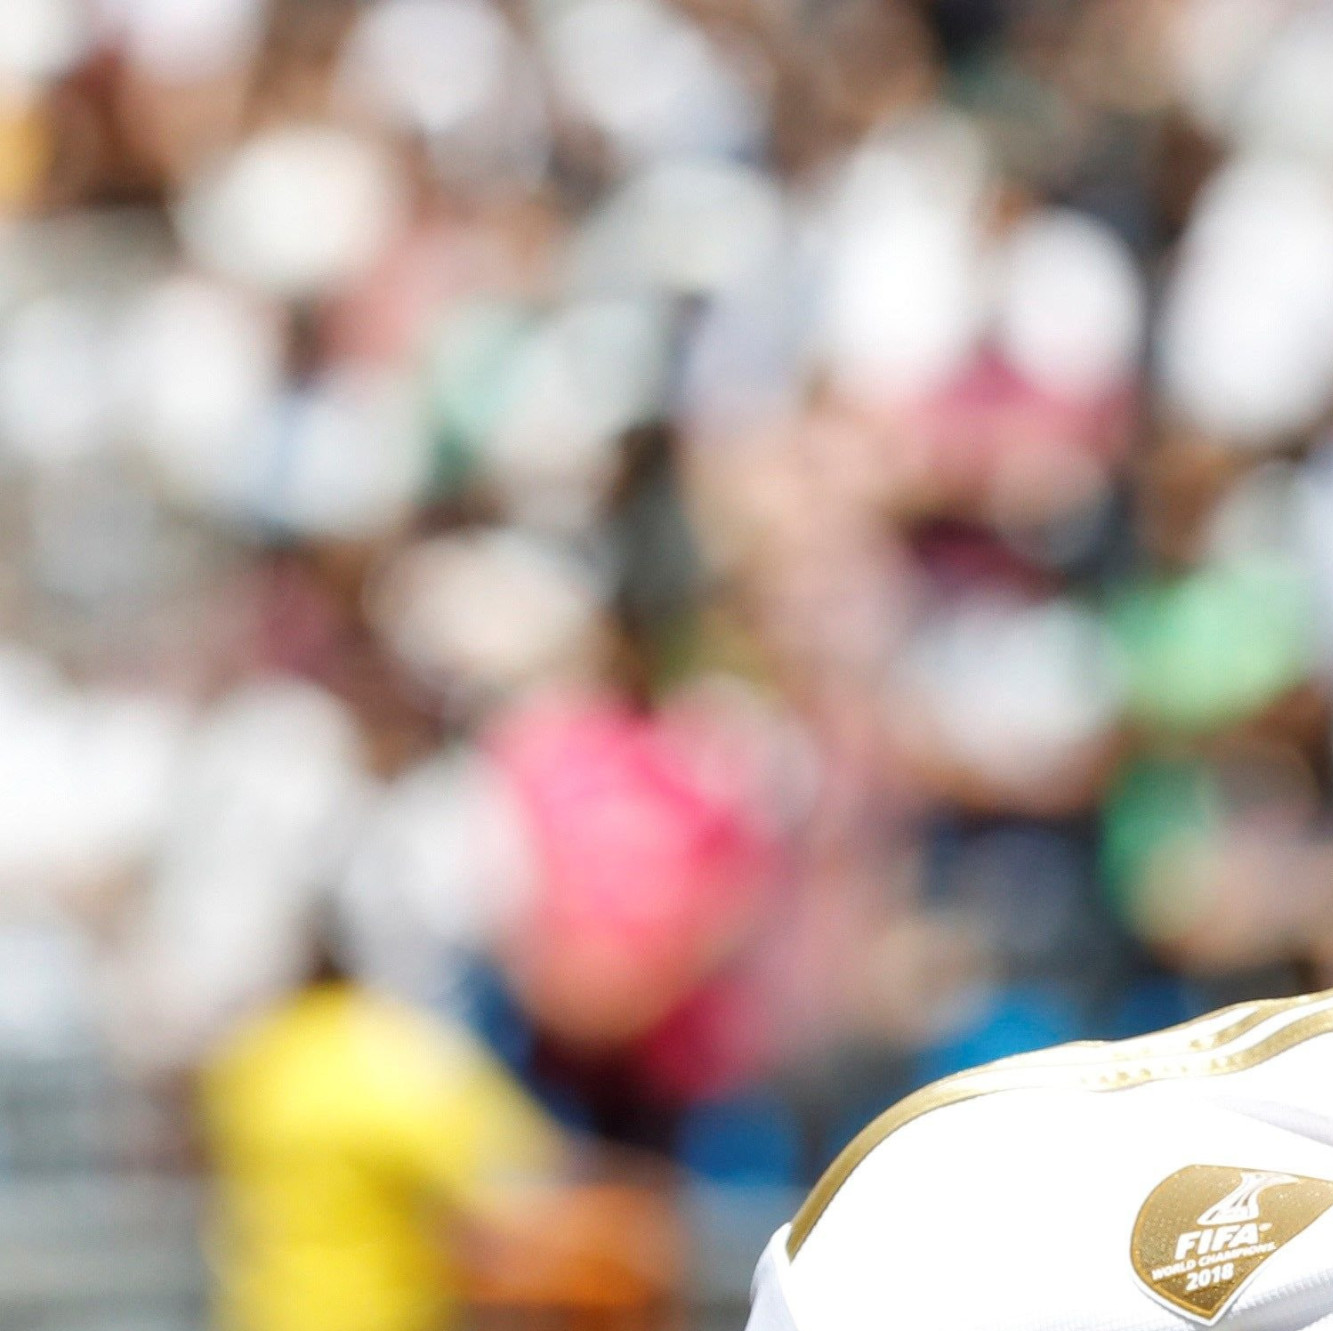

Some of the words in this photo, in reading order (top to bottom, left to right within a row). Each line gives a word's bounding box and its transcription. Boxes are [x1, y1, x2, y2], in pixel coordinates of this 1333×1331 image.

[1151, 1259, 1197, 1281] WORLD
[1198, 1241, 1277, 1267] CHAMPIONS
[1174, 1222, 1259, 1261] FIFA
[1185, 1262, 1235, 1291] 2018
